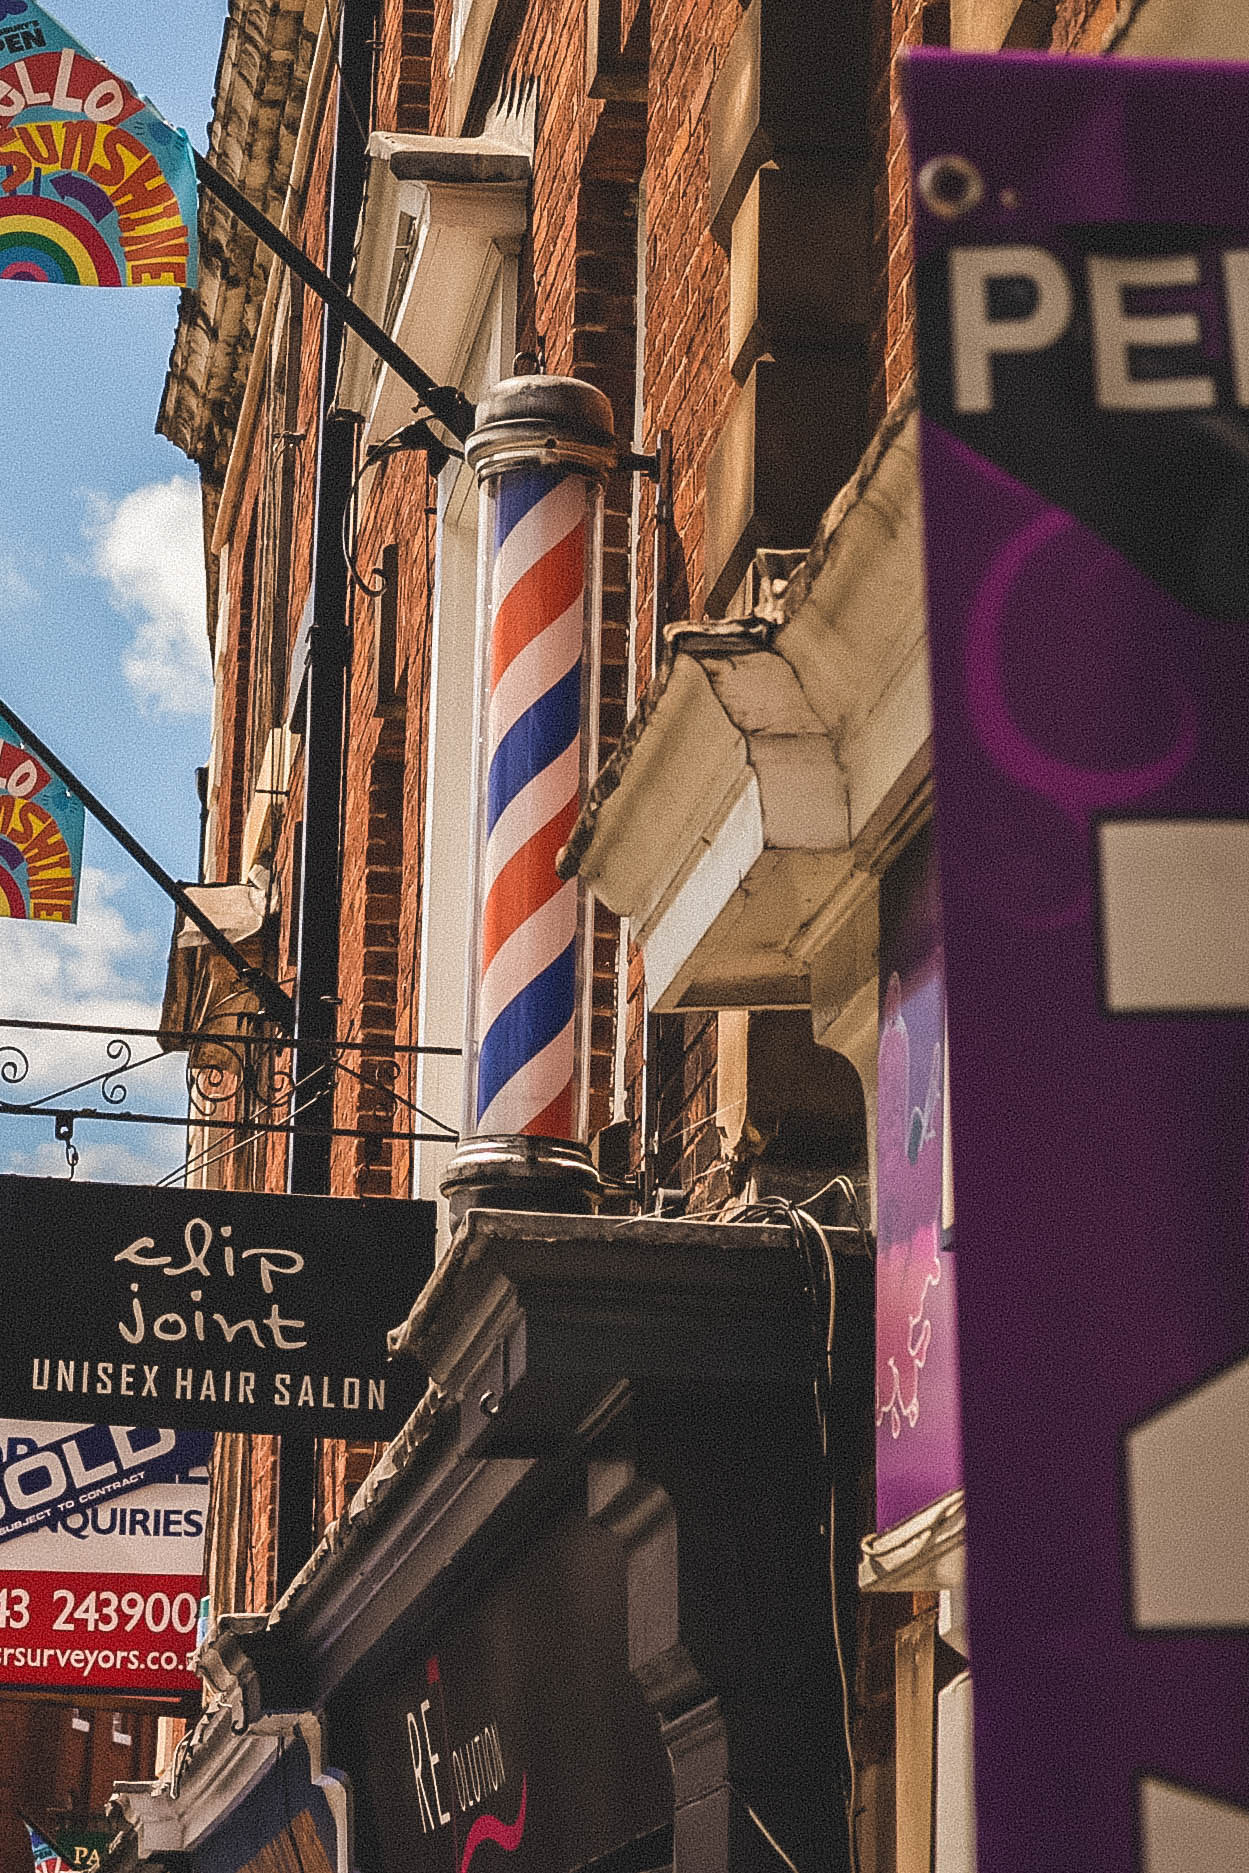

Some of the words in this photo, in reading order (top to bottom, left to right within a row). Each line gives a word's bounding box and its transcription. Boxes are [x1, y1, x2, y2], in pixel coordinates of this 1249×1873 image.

[114, 1218, 304, 1294] clip
[119, 1283, 308, 1349] joint
[32, 1358, 159, 1397] UNISEX
[175, 1368, 256, 1404] HAIR
[274, 1373, 386, 1411] SALON
[57, 1499, 75, 1512] TO
[79, 1471, 145, 1504] CONTRACT
[32, 1504, 204, 1540] QUIRIES
[52, 1589, 198, 1634] 243900
